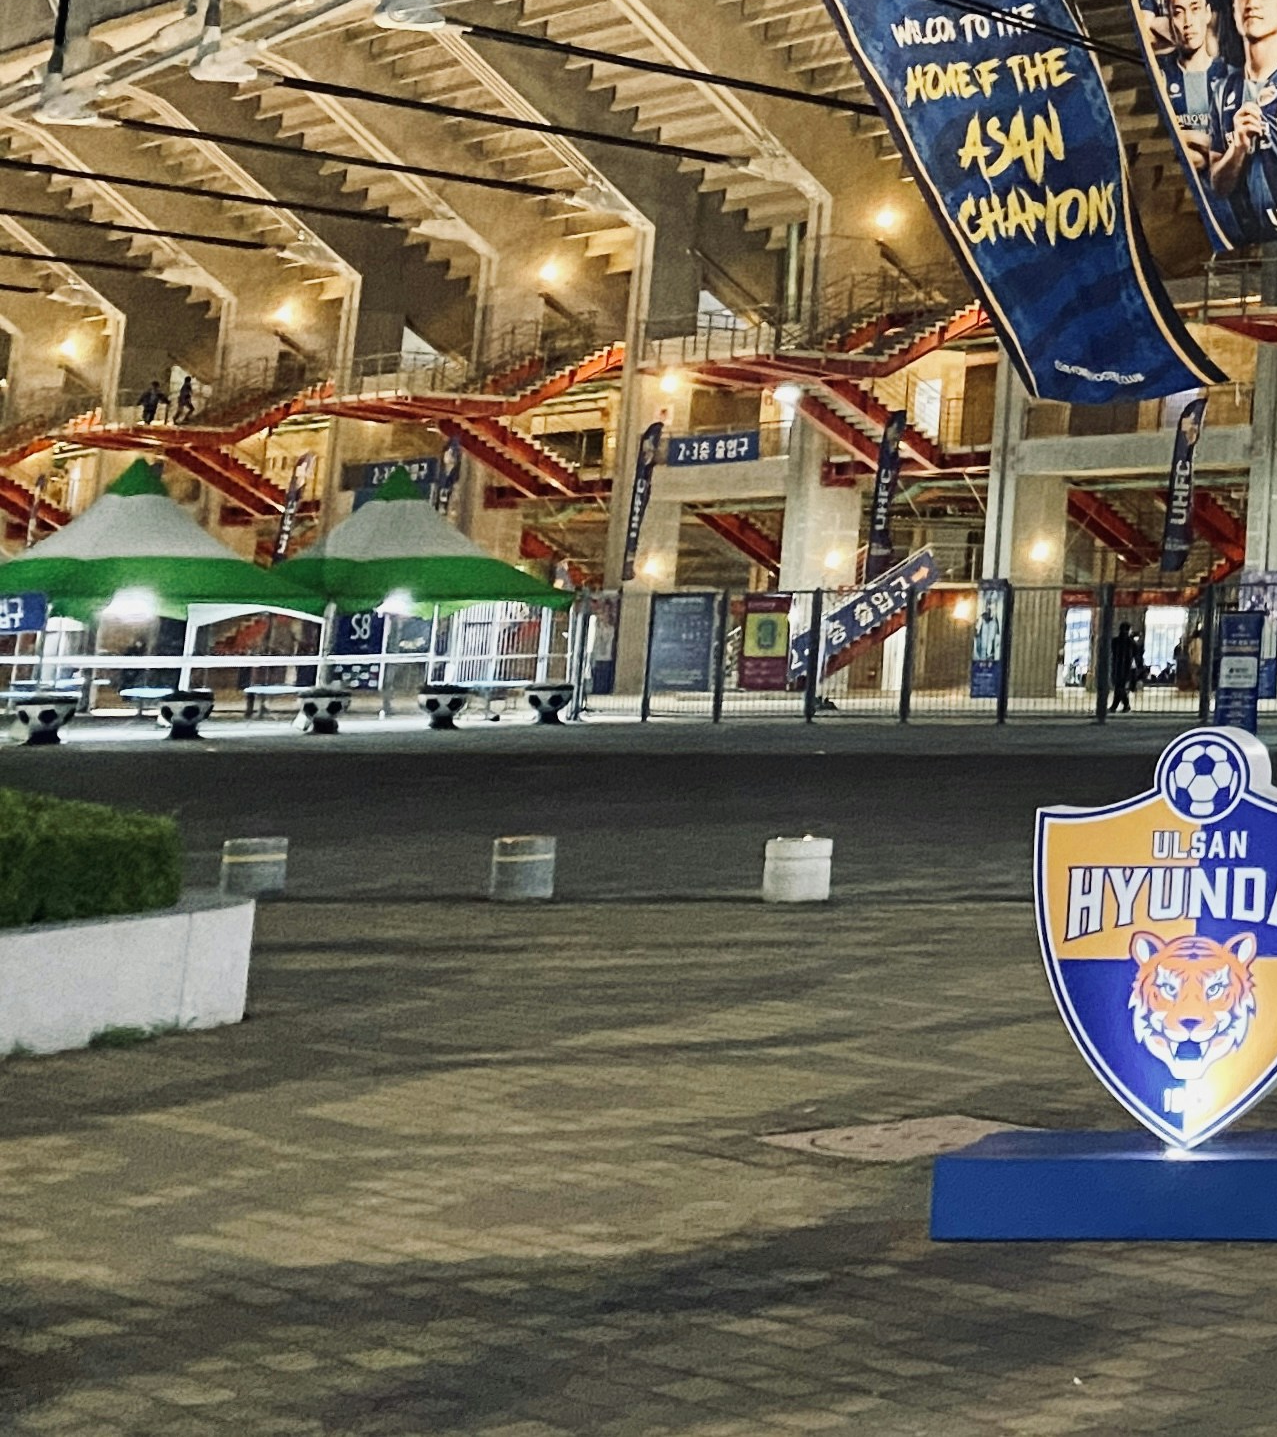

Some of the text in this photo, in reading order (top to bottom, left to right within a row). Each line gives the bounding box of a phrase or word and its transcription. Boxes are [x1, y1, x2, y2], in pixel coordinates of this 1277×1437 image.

[959, 13, 990, 43] TO
[1006, 47, 1077, 96] THE
[874, 468, 892, 531] UHFC
[1169, 459, 1191, 526] UHFC
[350, 613, 371, 640] S8
[1151, 829, 1249, 860] ULSAN
